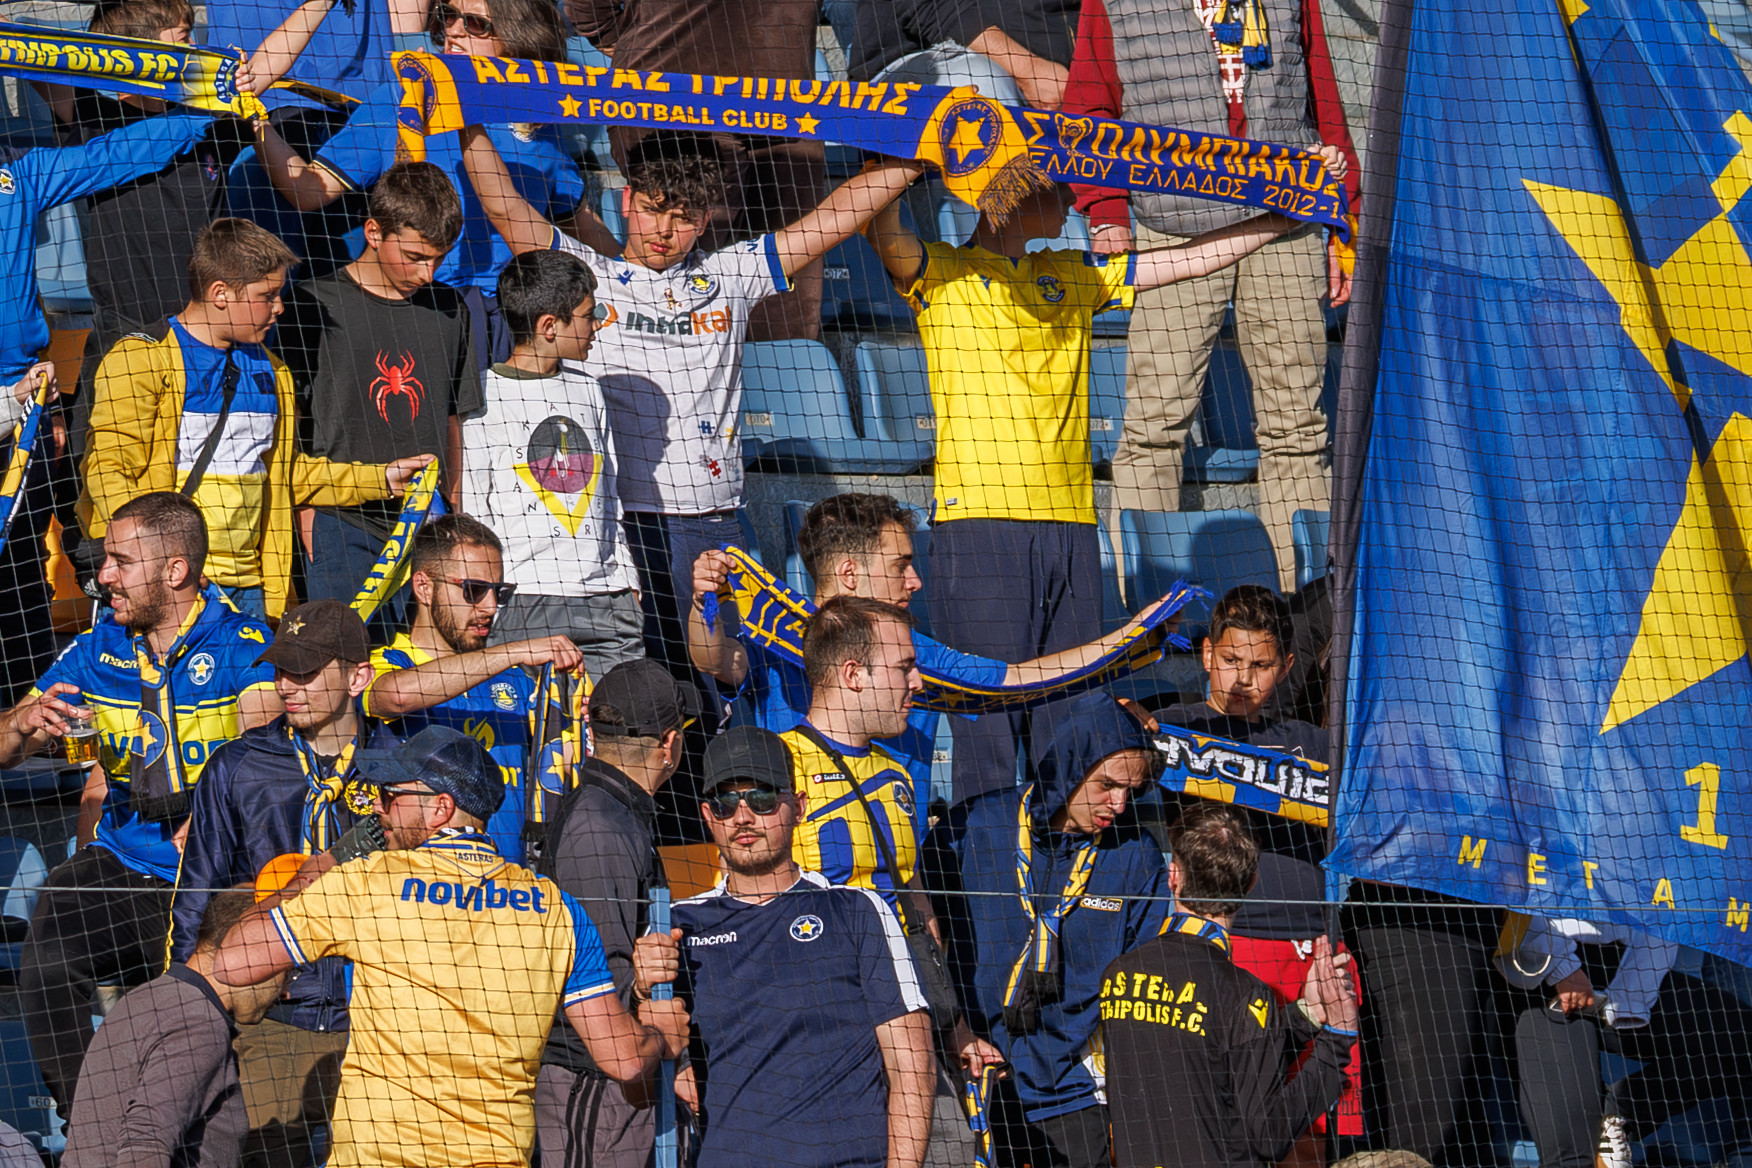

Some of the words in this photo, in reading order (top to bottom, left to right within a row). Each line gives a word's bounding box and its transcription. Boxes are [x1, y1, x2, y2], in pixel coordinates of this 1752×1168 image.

[137, 52, 179, 81] FC
[588, 98, 715, 126] FOOTBALL
[722, 107, 788, 131] CLUB
[1129, 164, 1247, 200] ΕΛΛΑΔΟΣ
[1263, 185, 1348, 223] 2012-1
[458, 852, 494, 864] ASTERAS
[401, 877, 547, 914] novibet
[1082, 897, 1120, 911] adidas
[687, 931, 737, 947] macron
